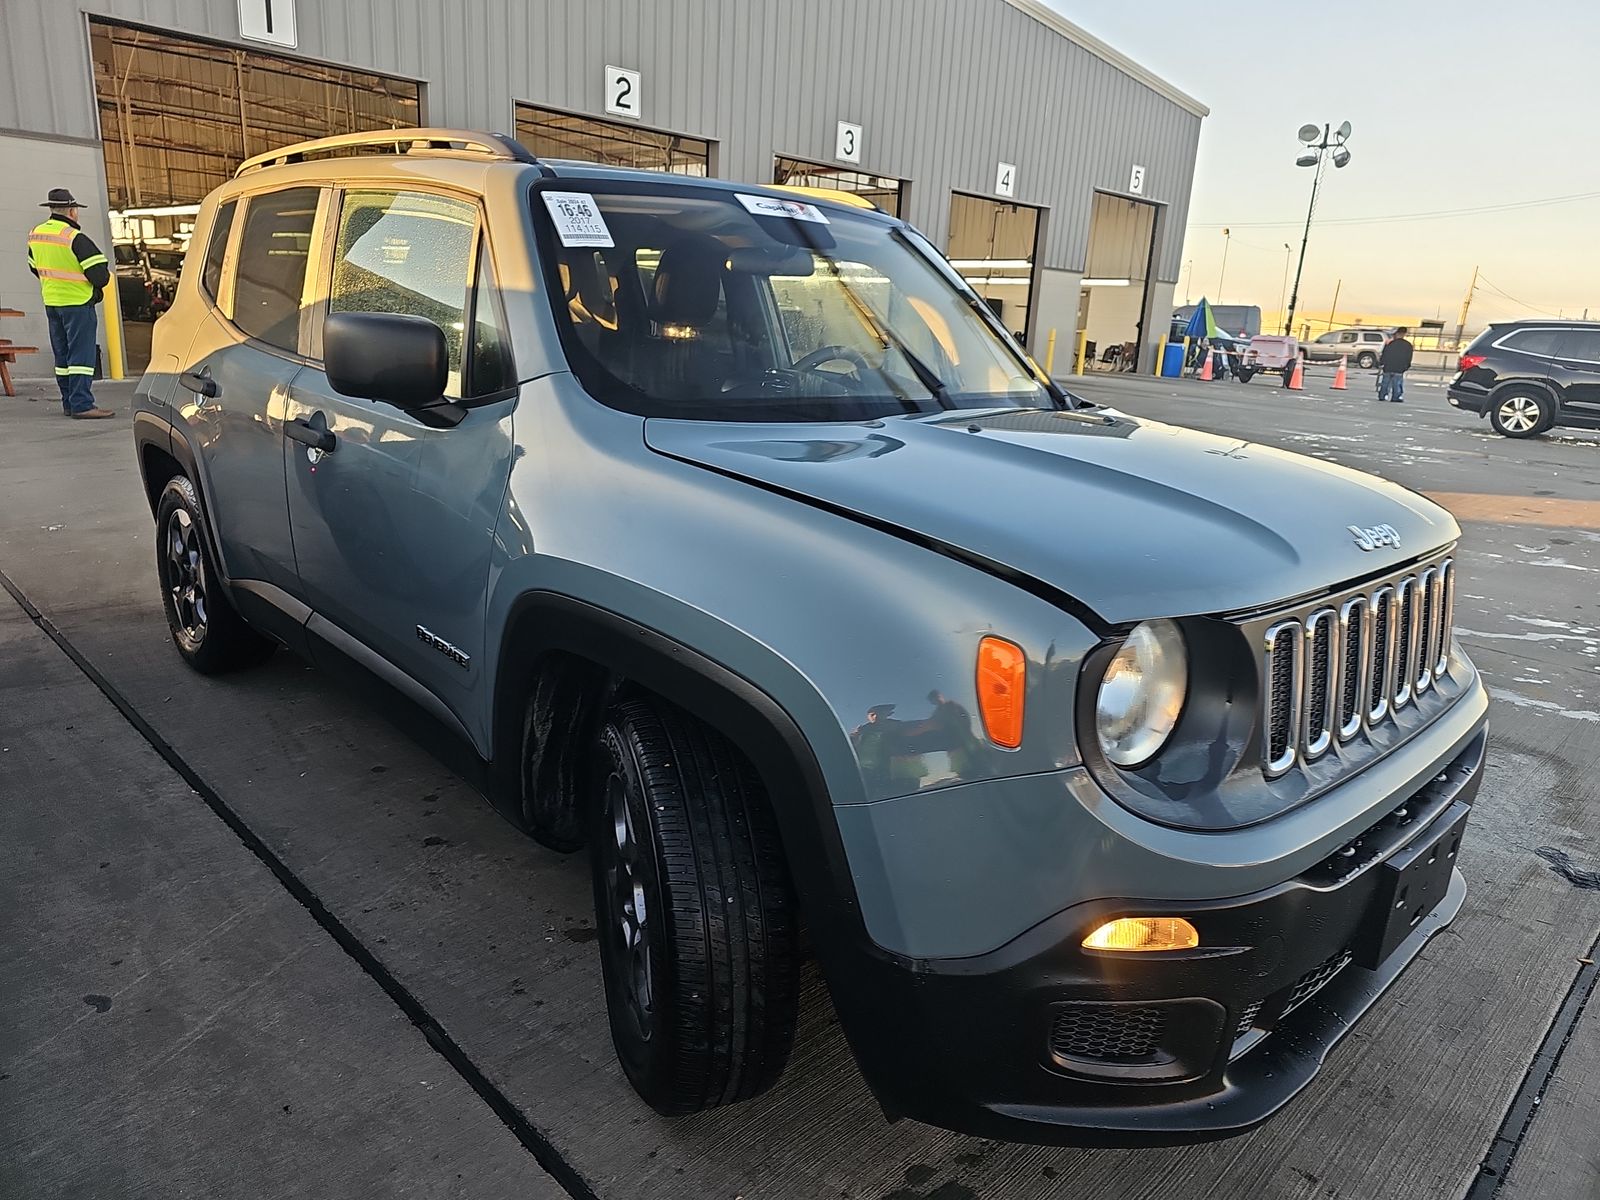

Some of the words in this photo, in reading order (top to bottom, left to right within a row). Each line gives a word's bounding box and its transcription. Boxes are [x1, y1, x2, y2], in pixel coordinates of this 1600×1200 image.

[616, 76, 631, 109] 2
[843, 130, 854, 155] 3
[1001, 170, 1009, 191] 4
[1133, 170, 1141, 188] 5
[558, 203, 593, 217] 16:46
[569, 216, 590, 225] 2017
[1346, 523, 1401, 552] Jeep
